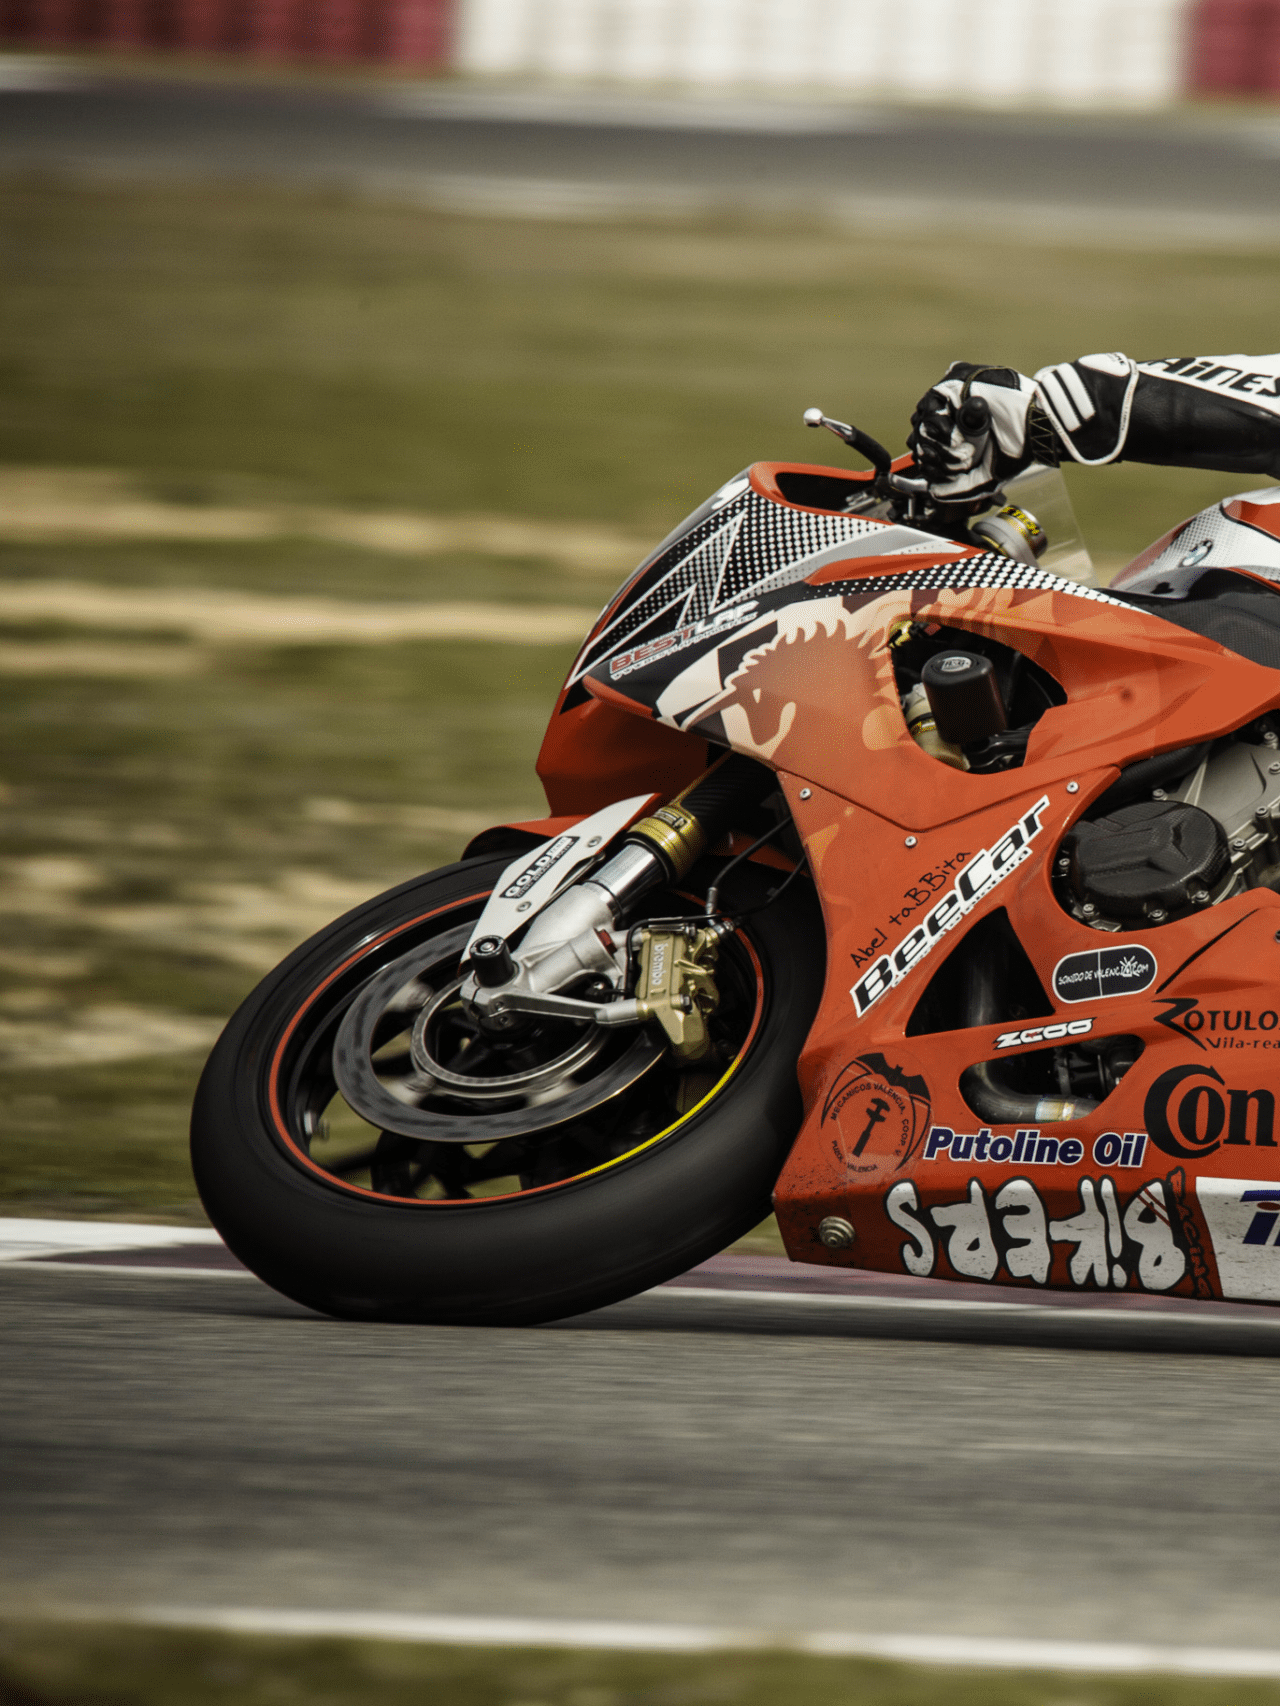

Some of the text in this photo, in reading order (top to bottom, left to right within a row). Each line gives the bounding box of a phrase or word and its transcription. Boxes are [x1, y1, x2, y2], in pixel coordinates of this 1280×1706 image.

[505, 855, 552, 897] GOLD
[851, 796, 1049, 1017] BeeCar
[650, 943, 669, 985] brembo
[850, 928, 888, 968] Abel
[923, 1127, 1148, 1168] Putoline Oil
